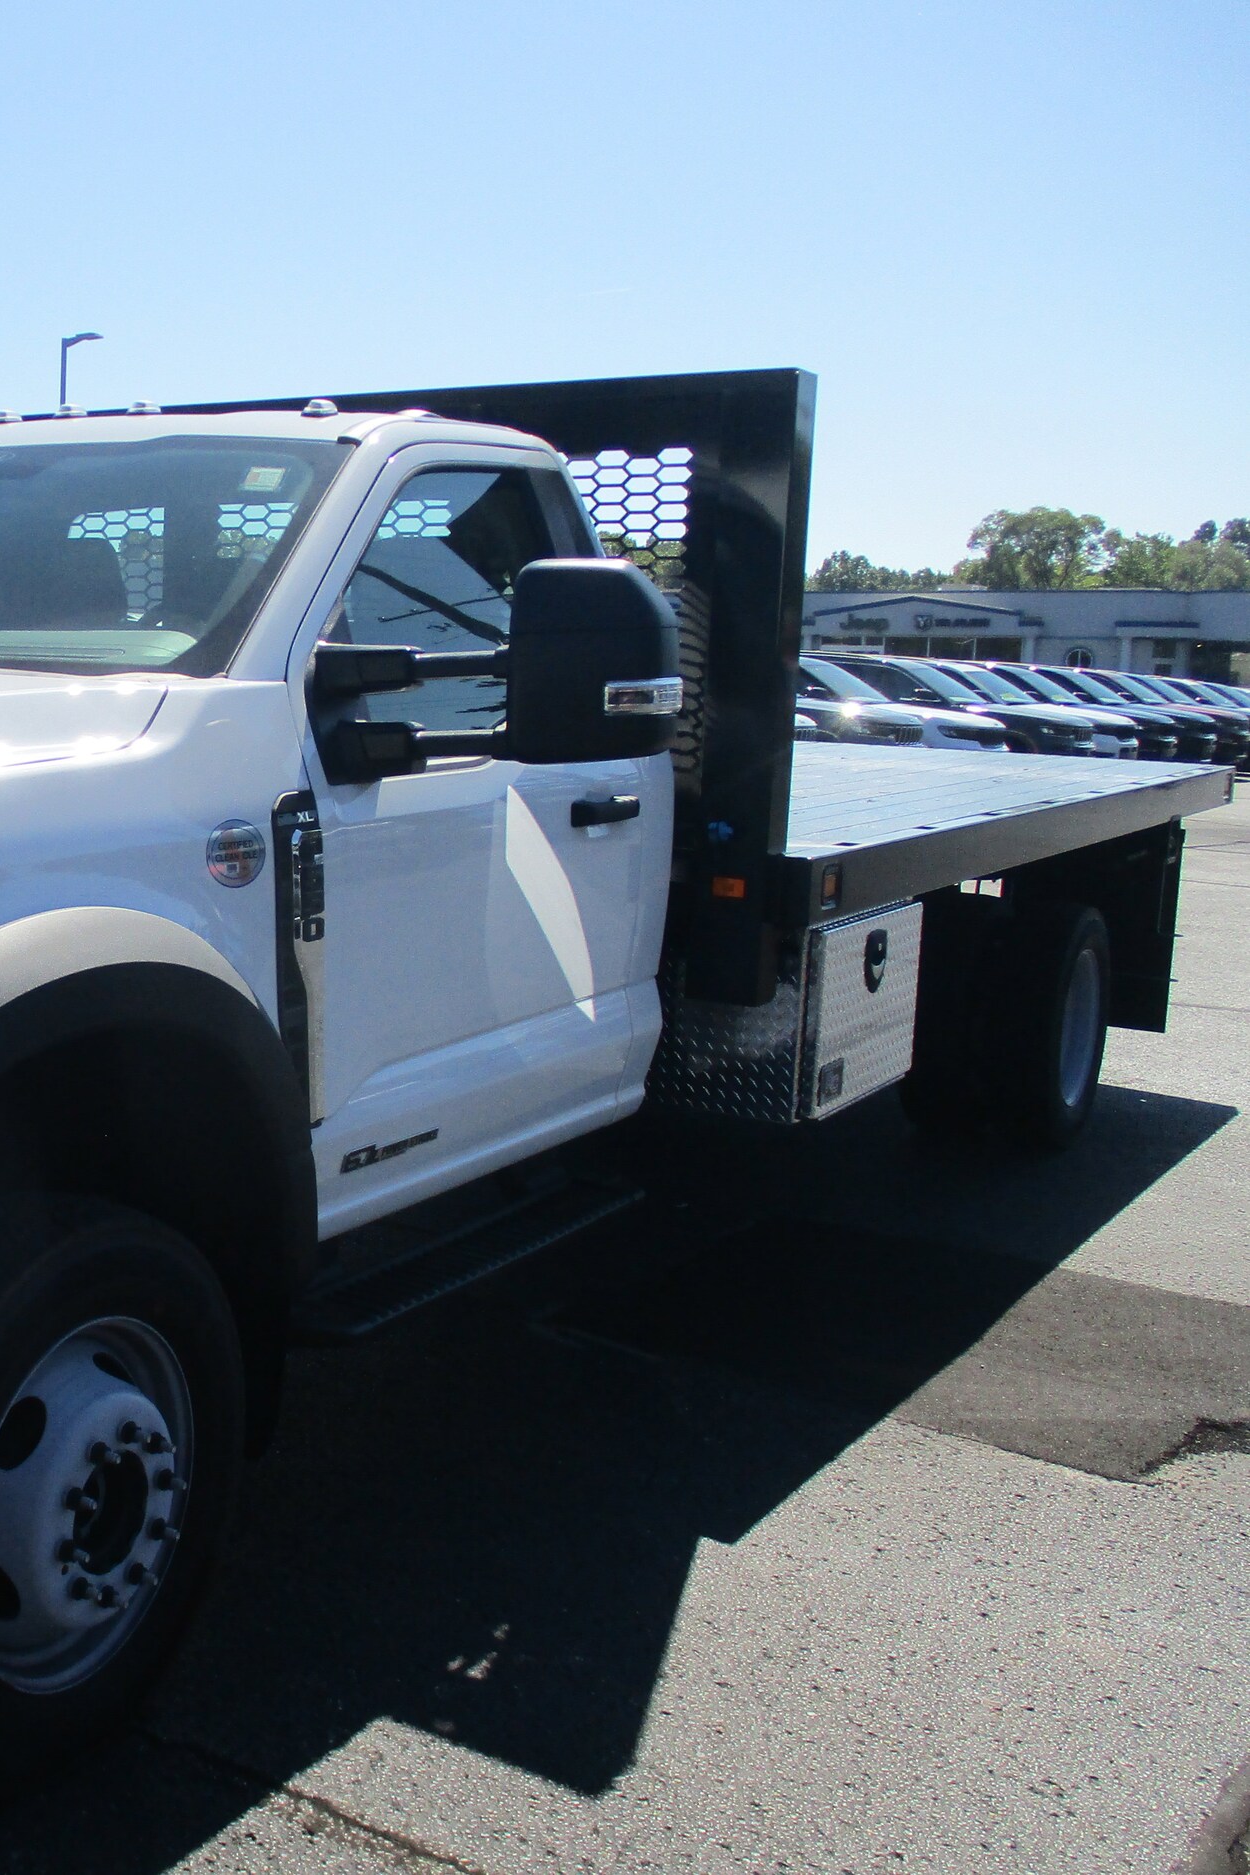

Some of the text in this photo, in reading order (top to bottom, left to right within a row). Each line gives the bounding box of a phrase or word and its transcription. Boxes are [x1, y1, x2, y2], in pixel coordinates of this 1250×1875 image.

[296, 810, 315, 823] XL
[218, 839, 254, 851] CERTIFIED
[214, 853, 240, 863] CLEAN
